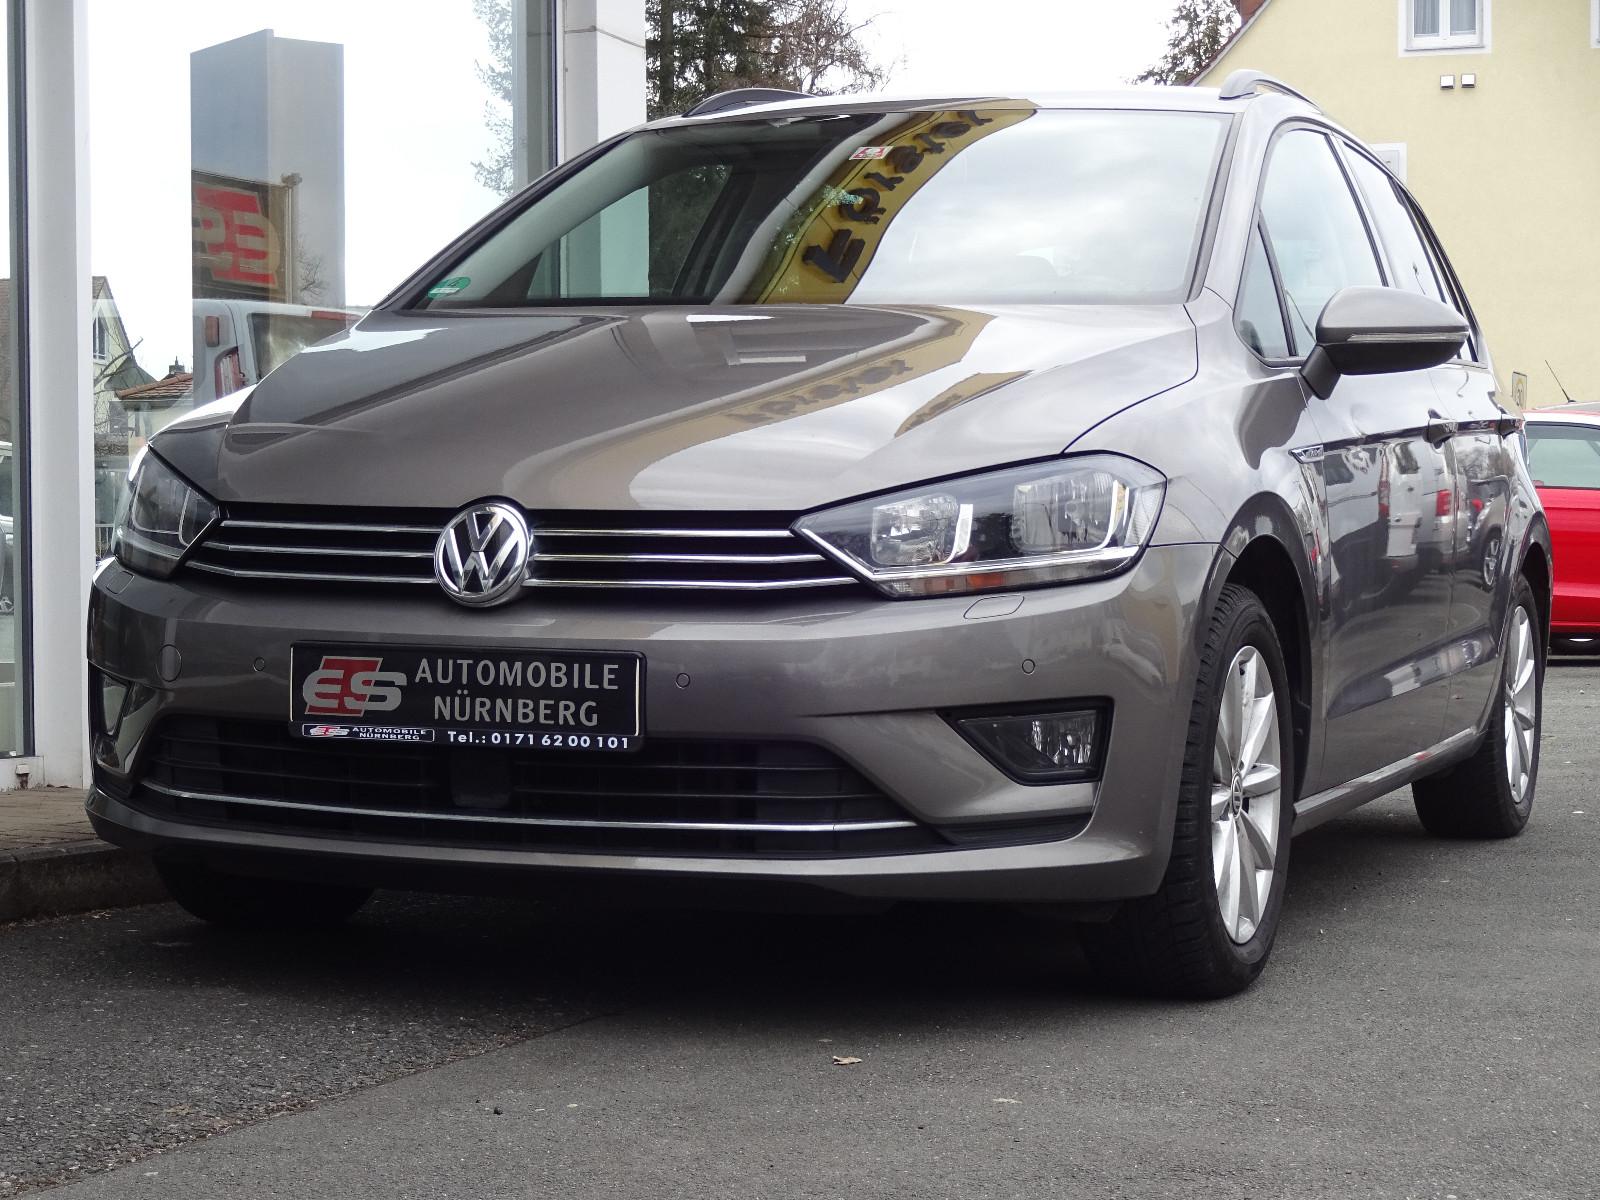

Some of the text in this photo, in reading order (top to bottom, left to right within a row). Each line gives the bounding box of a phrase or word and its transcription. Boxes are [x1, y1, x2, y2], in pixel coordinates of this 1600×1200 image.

[415, 658, 619, 690] AUTOMOBILE
[434, 689, 598, 726] NÜRNBERG
[352, 727, 426, 735] AUTOMOBILE
[359, 732, 420, 740] NÜRNBERG
[447, 731, 486, 743] Tel.:
[491, 732, 534, 745] 0171
[597, 736, 628, 749] 101
